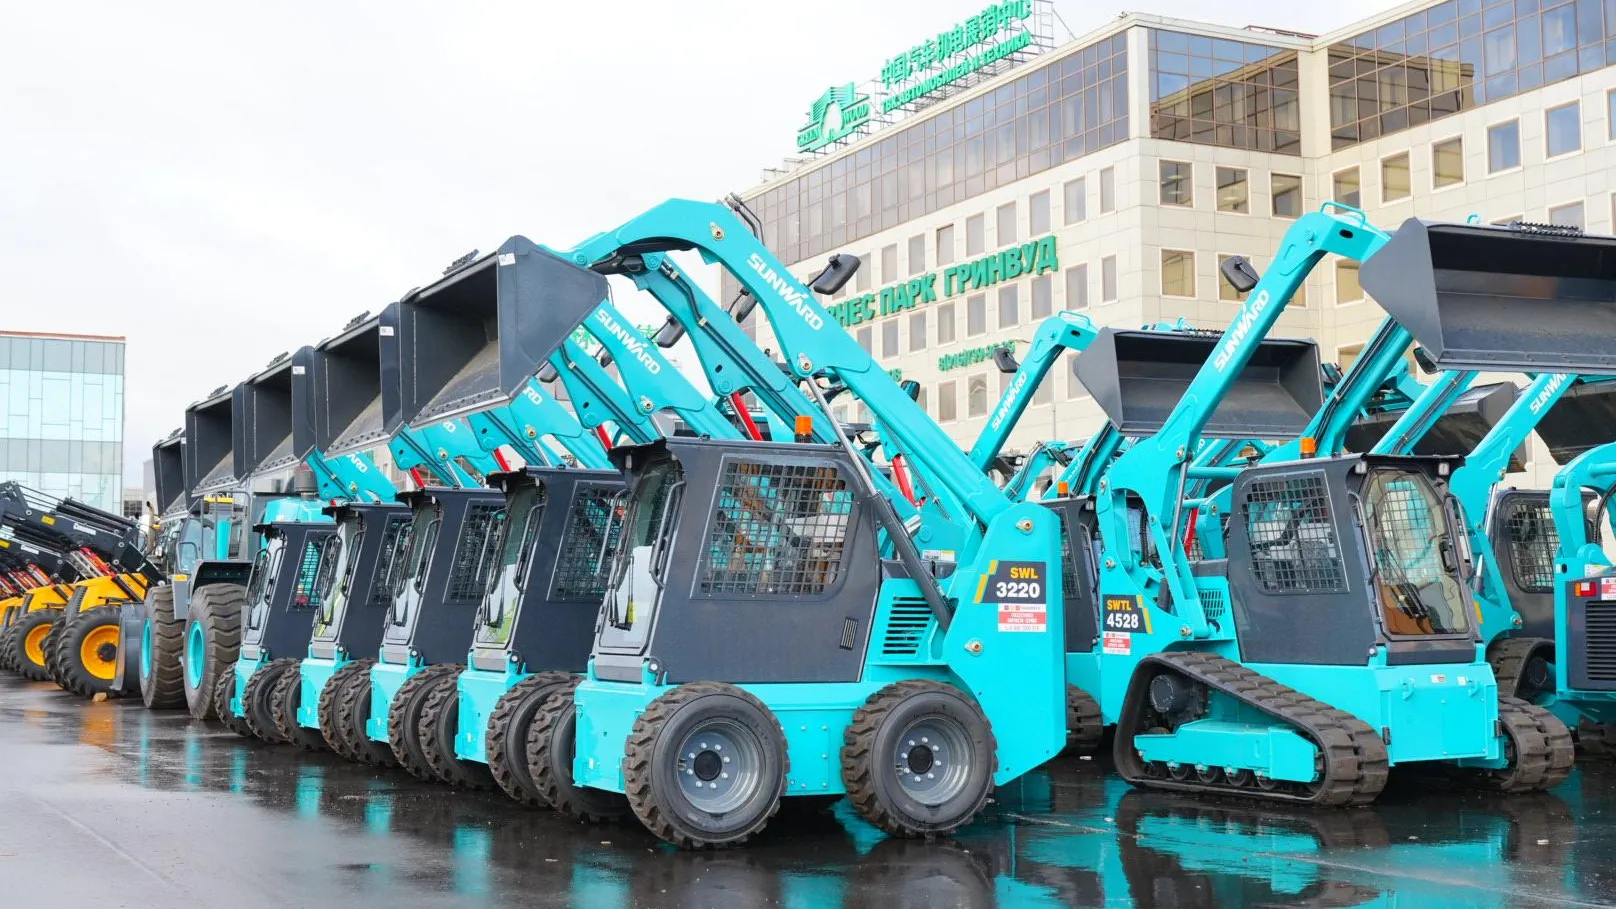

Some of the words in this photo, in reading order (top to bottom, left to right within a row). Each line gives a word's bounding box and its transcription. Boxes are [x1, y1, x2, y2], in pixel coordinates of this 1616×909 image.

[747, 252, 824, 331] SUNWARD
[880, 272, 937, 316] ПАРК
[944, 235, 1058, 297] ГРИНВУД
[595, 309, 661, 375] SUNWARD
[1213, 289, 1270, 374] SUNWARD
[991, 370, 1027, 432] SUNWARD
[996, 582, 1041, 599] 3220
[1010, 567, 1038, 579] SWL
[1106, 599, 1132, 611] SWTL
[1106, 612, 1139, 629] 4528
